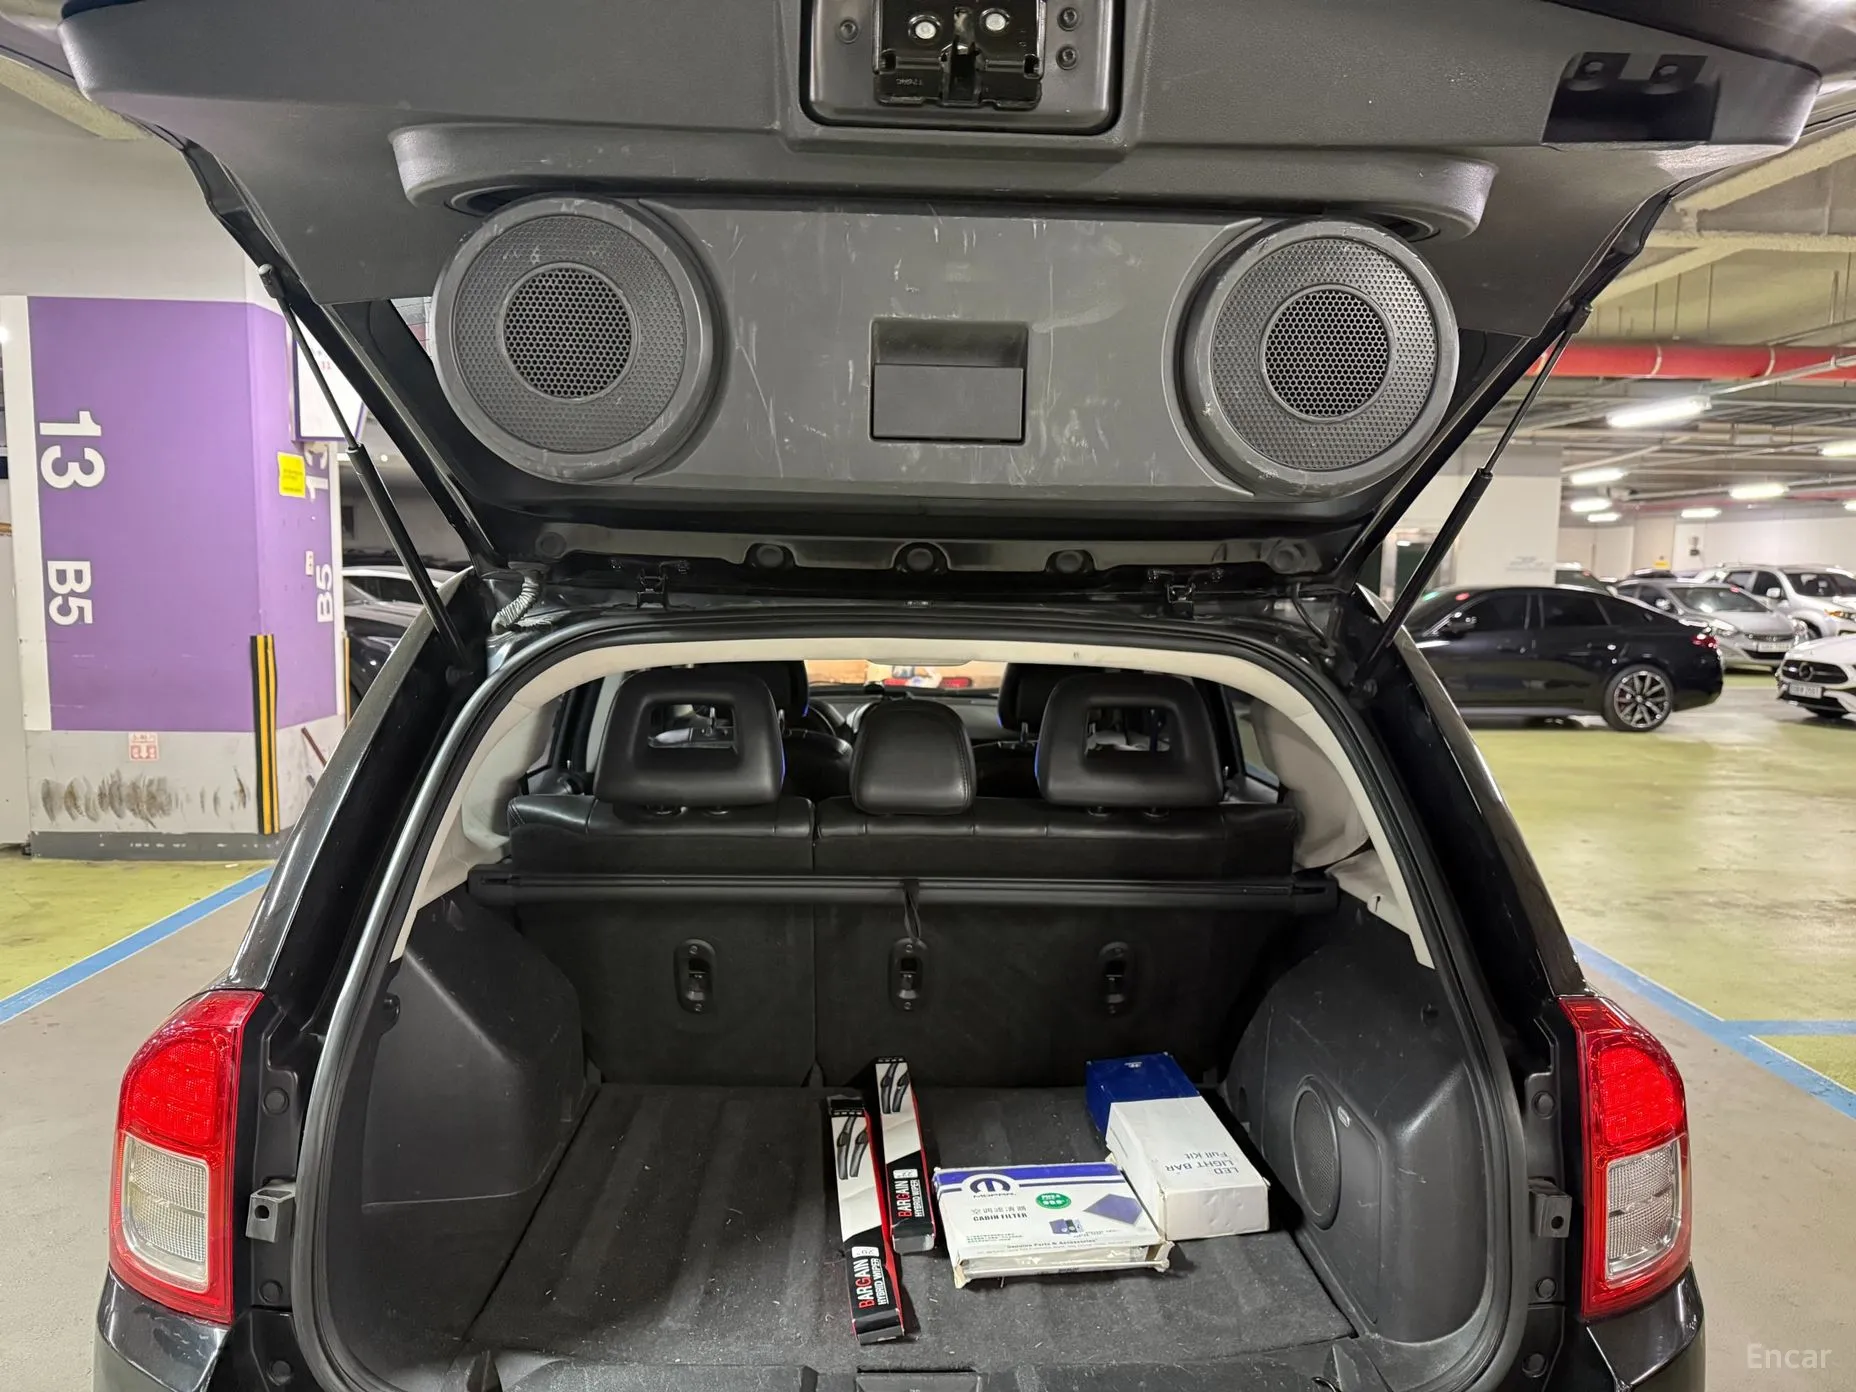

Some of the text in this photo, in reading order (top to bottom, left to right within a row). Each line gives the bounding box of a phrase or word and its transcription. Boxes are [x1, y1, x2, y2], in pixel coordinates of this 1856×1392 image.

[39, 410, 105, 625] 13 B5
[316, 563, 333, 623] B5
[1165, 1159, 1234, 1171] LIGHT BAR
[1213, 1166, 1239, 1174] LED
[895, 1180, 912, 1217] BARGAIN
[853, 1259, 875, 1309] BARGAIN
[871, 1258, 887, 1305] HYBRID WIPER
